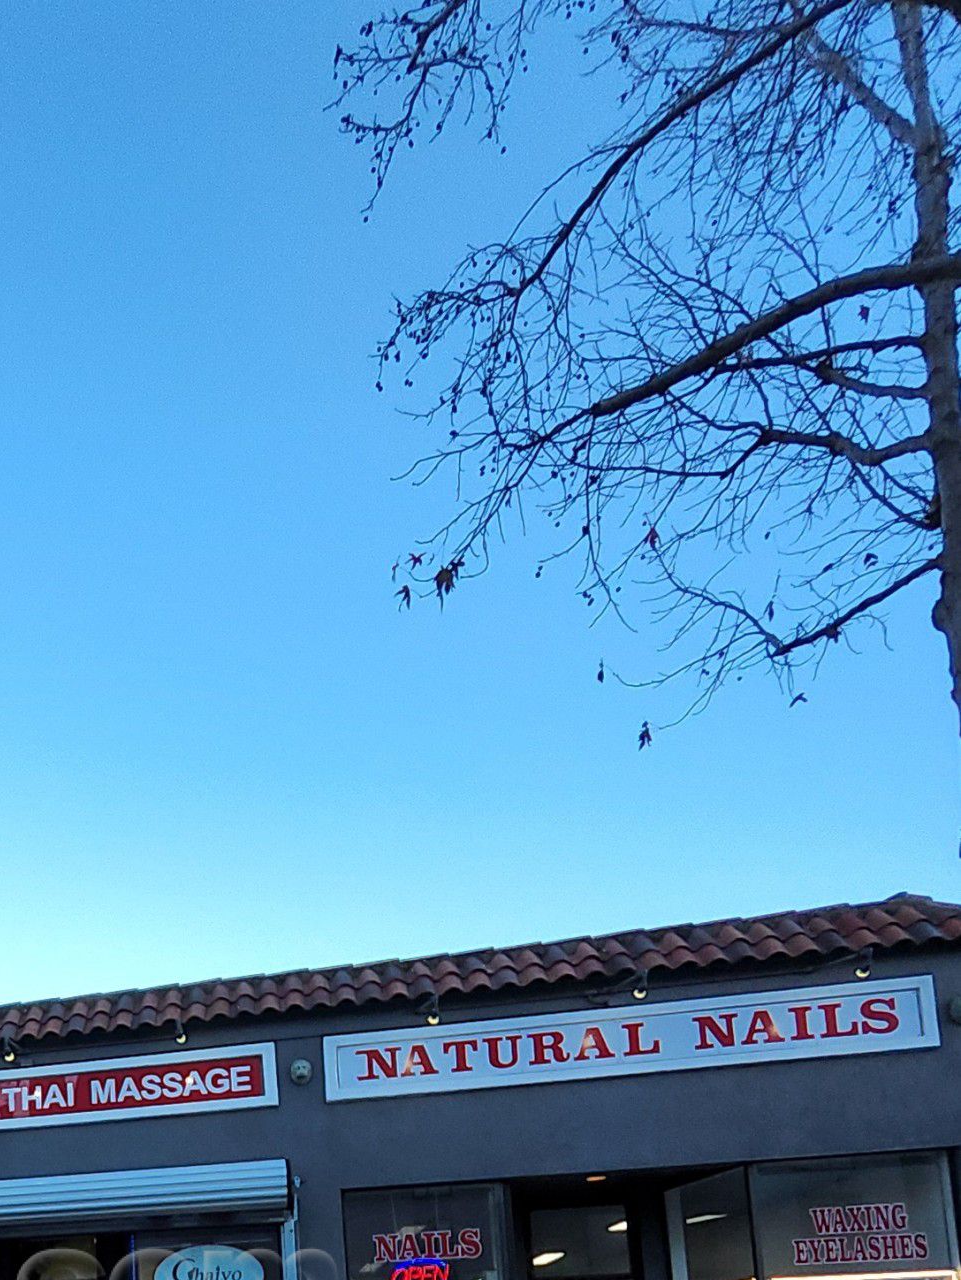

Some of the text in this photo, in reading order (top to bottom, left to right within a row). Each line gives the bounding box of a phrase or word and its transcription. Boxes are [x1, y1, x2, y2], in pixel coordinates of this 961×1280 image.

[356, 997, 901, 1082] NATURAL NAILS
[1, 1081, 76, 1113] THAI
[90, 1065, 253, 1106] MASSAGE
[809, 1202, 909, 1236] WAXING
[372, 1228, 483, 1263] NAILS
[792, 1232, 929, 1266] EYELASHES
